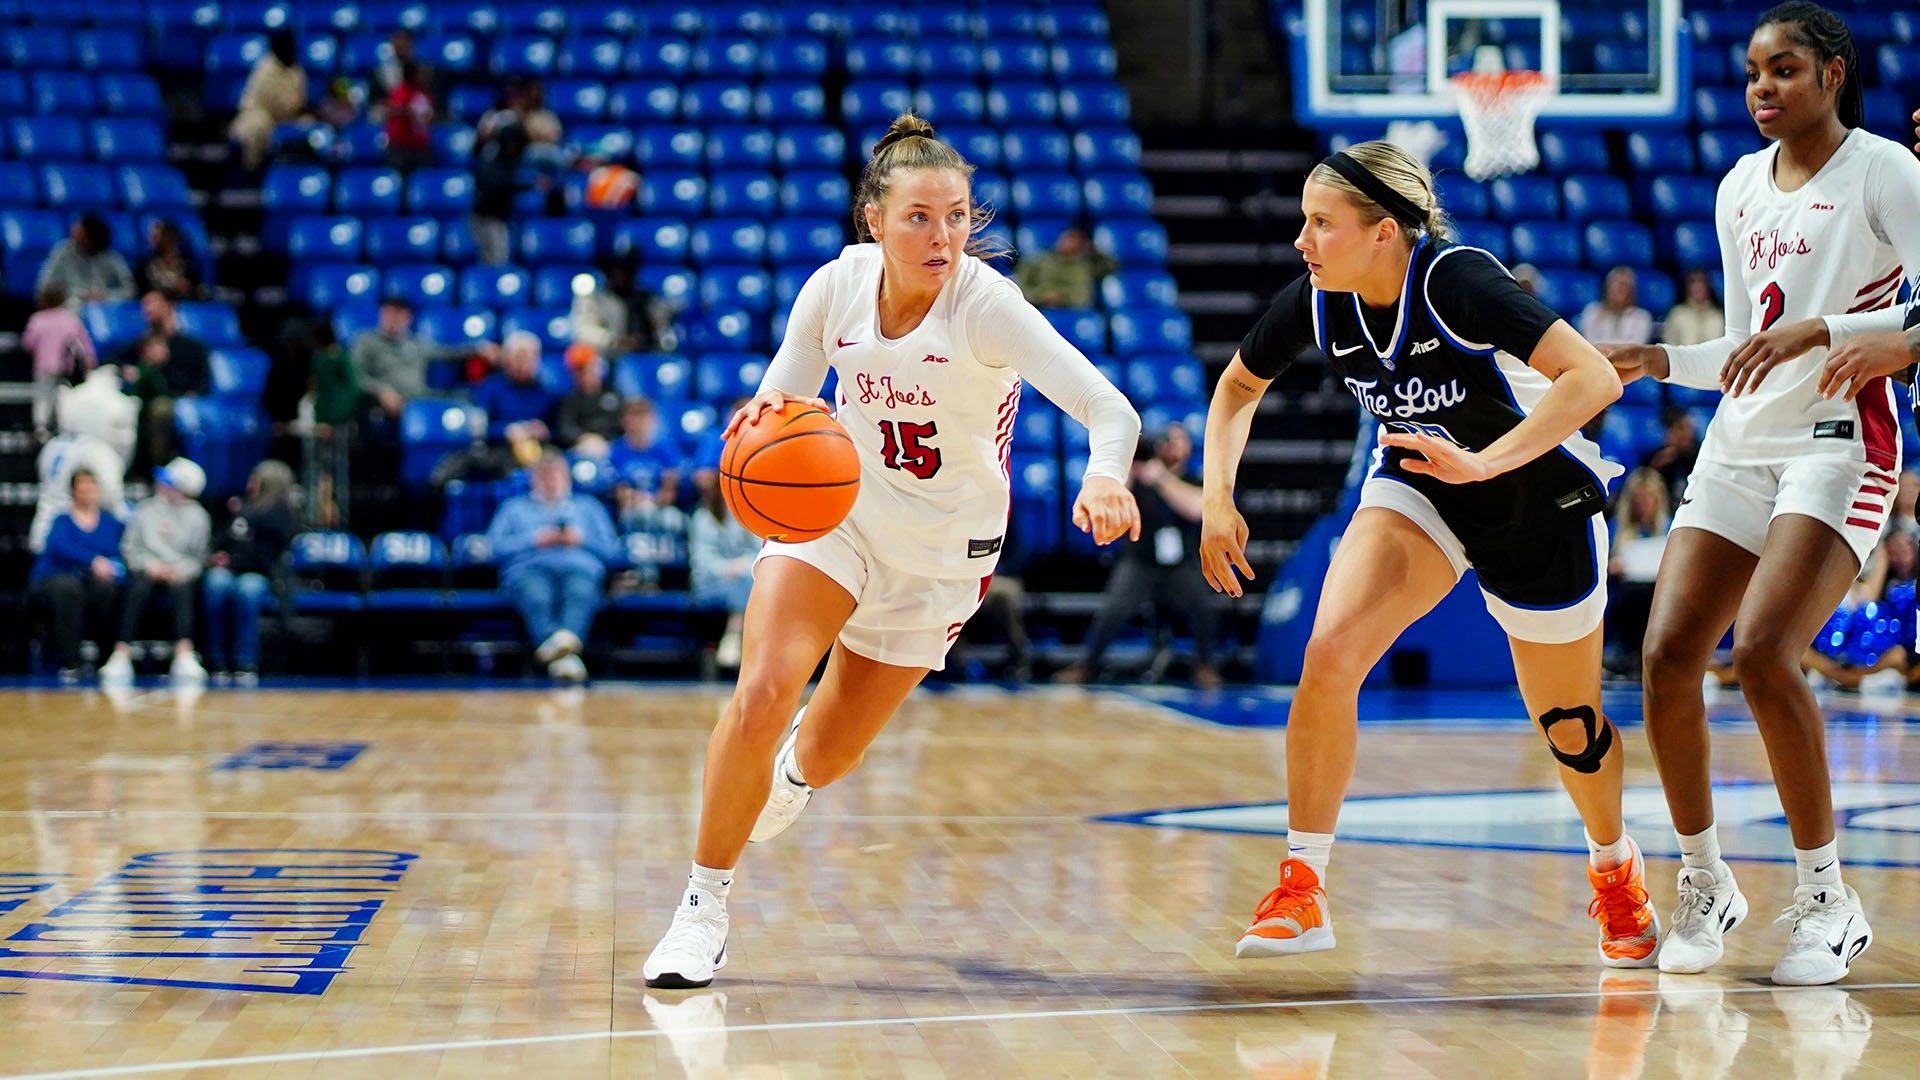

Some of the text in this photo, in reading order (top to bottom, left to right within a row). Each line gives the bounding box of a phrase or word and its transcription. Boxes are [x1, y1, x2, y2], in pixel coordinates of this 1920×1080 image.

[1768, 228, 1812, 270] Joe's
[1760, 281, 1786, 332] 2
[856, 373, 937, 409] St. Joe's
[1344, 376, 1467, 418] The Lou
[877, 419, 943, 480] 15
[1841, 424, 1849, 433] M
